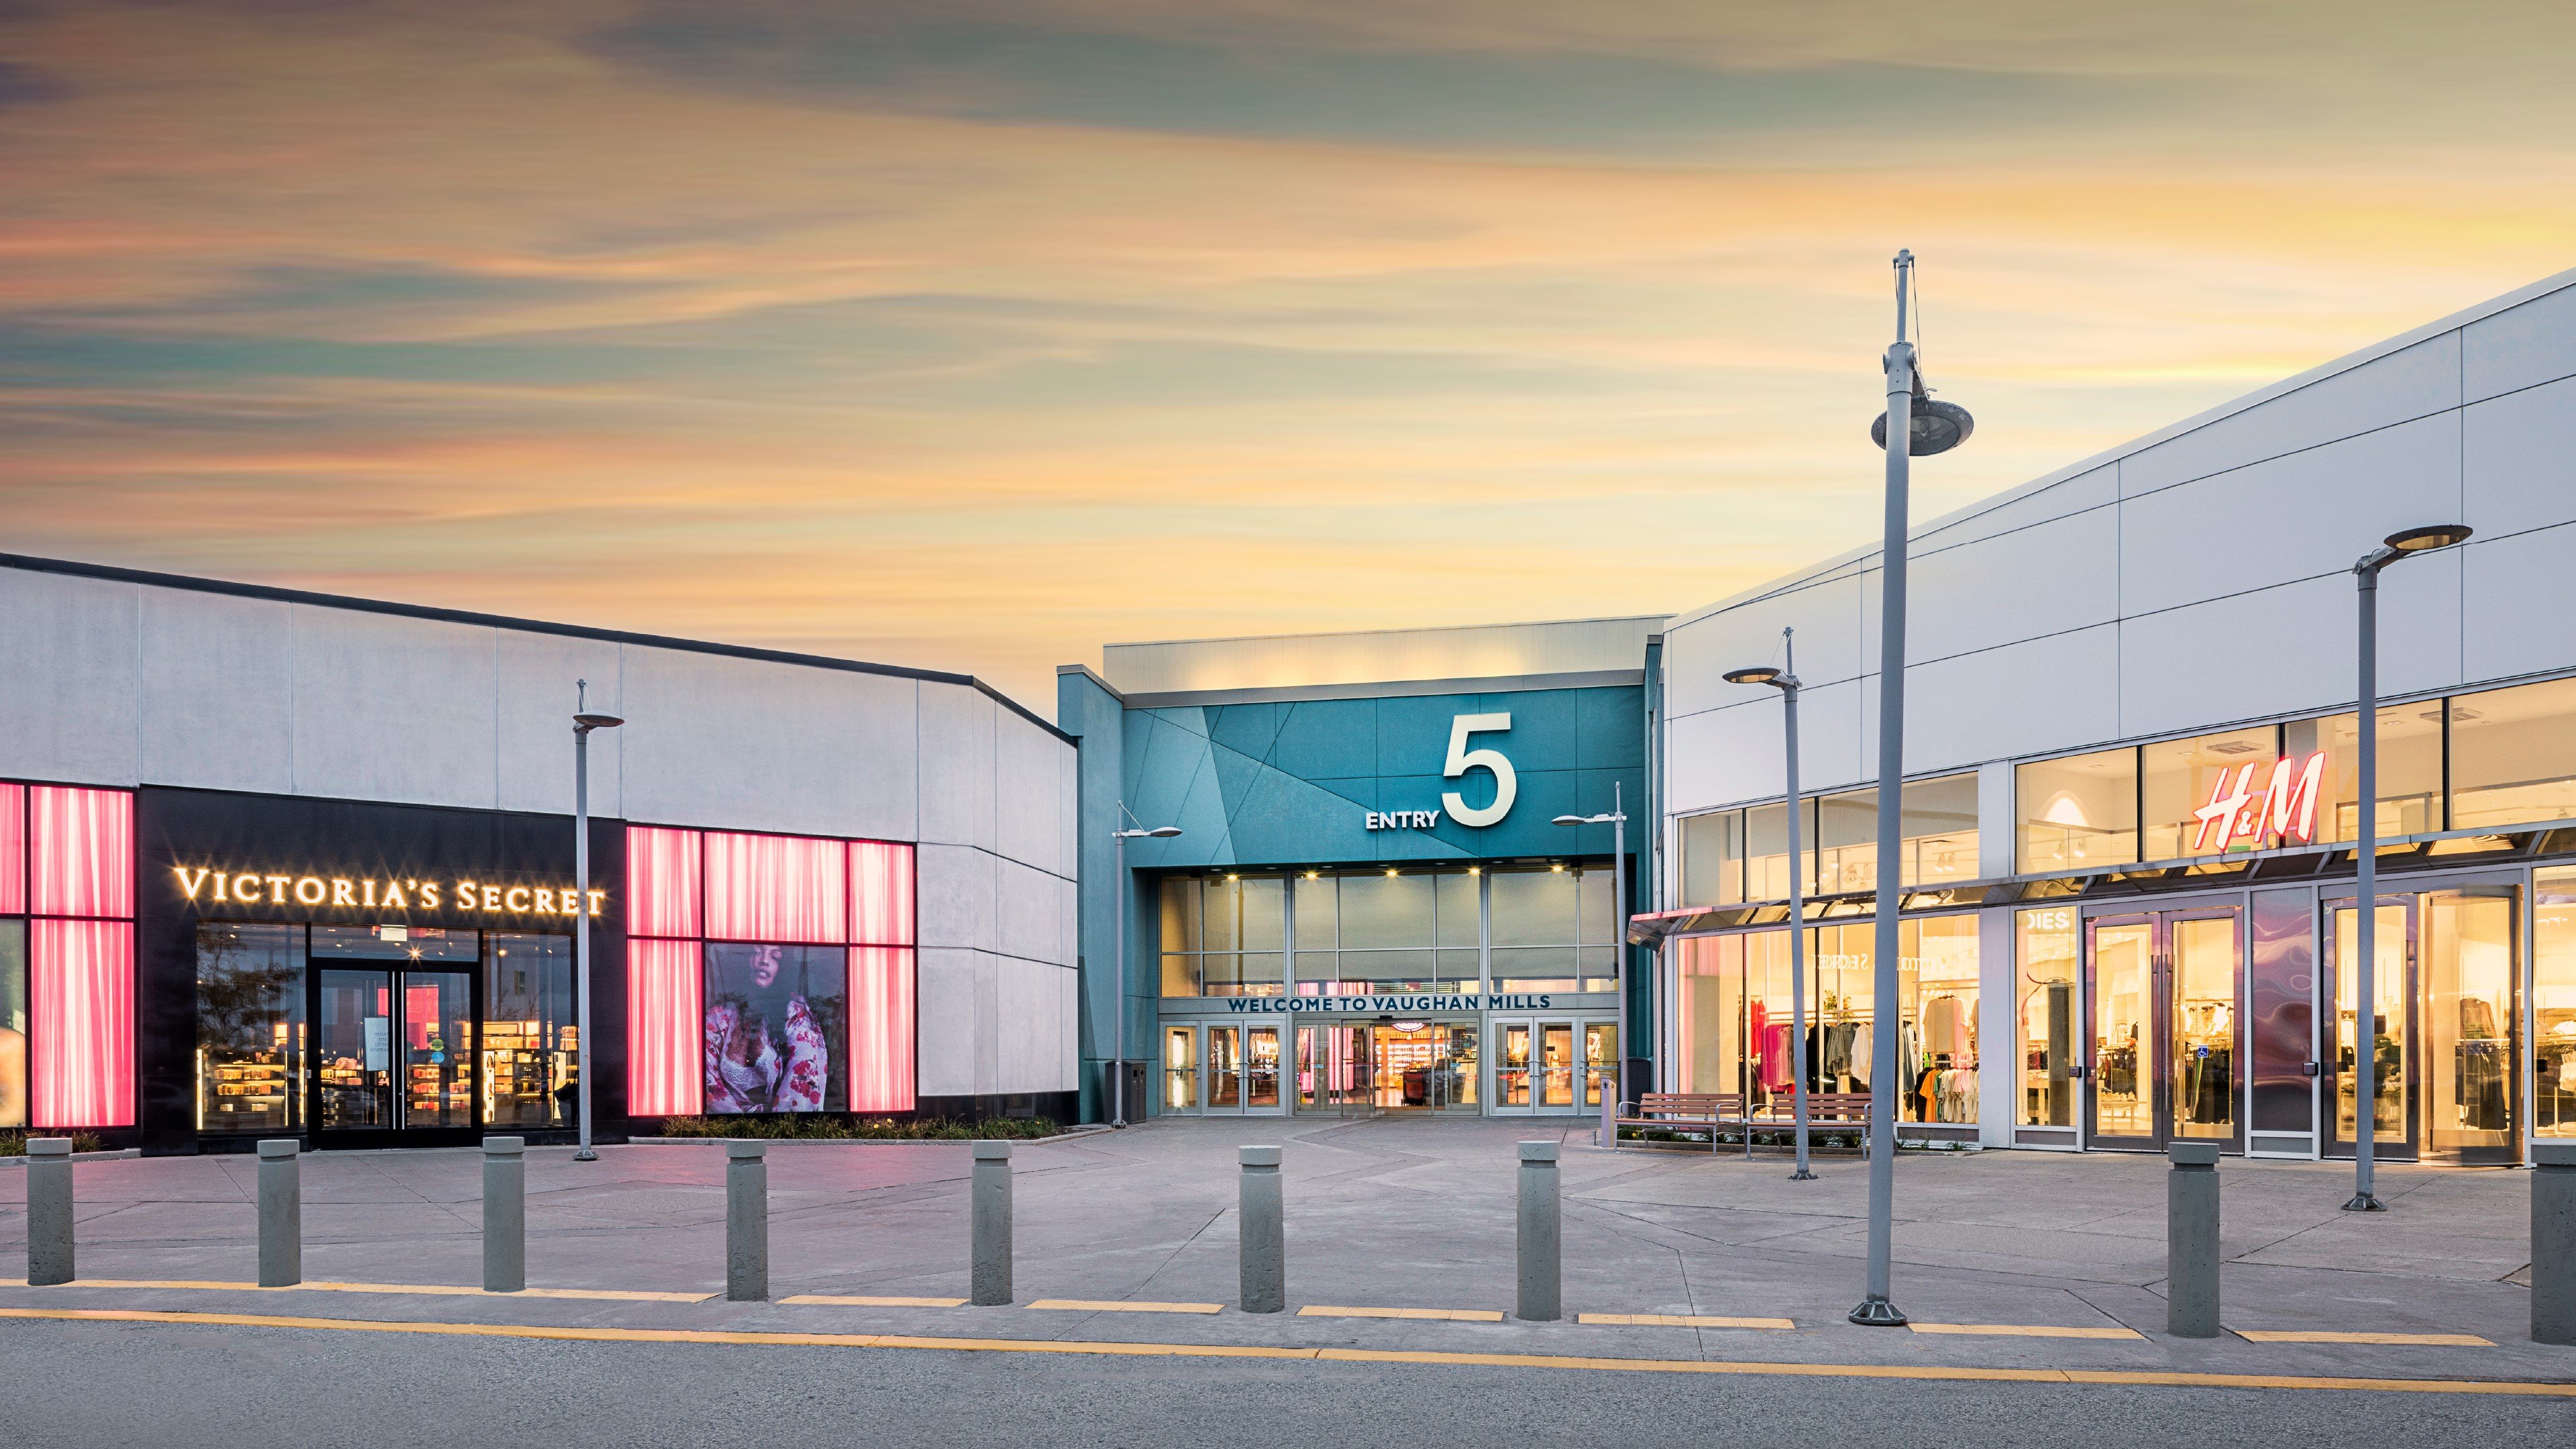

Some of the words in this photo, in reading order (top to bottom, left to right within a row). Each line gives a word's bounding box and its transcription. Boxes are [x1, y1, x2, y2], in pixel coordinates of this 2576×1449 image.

[1365, 810, 1440, 829] ENTRY
[1442, 712, 1517, 826] 5
[2193, 751, 2326, 850] H&M
[174, 867, 439, 908] VICTORIA'S
[457, 881, 604, 915] SECRET
[1228, 998, 1332, 1012] WELCOME
[1338, 997, 1366, 1011] TO
[1372, 996, 1479, 1010] VAUGHAN
[1489, 995, 1550, 1009] MILLS
